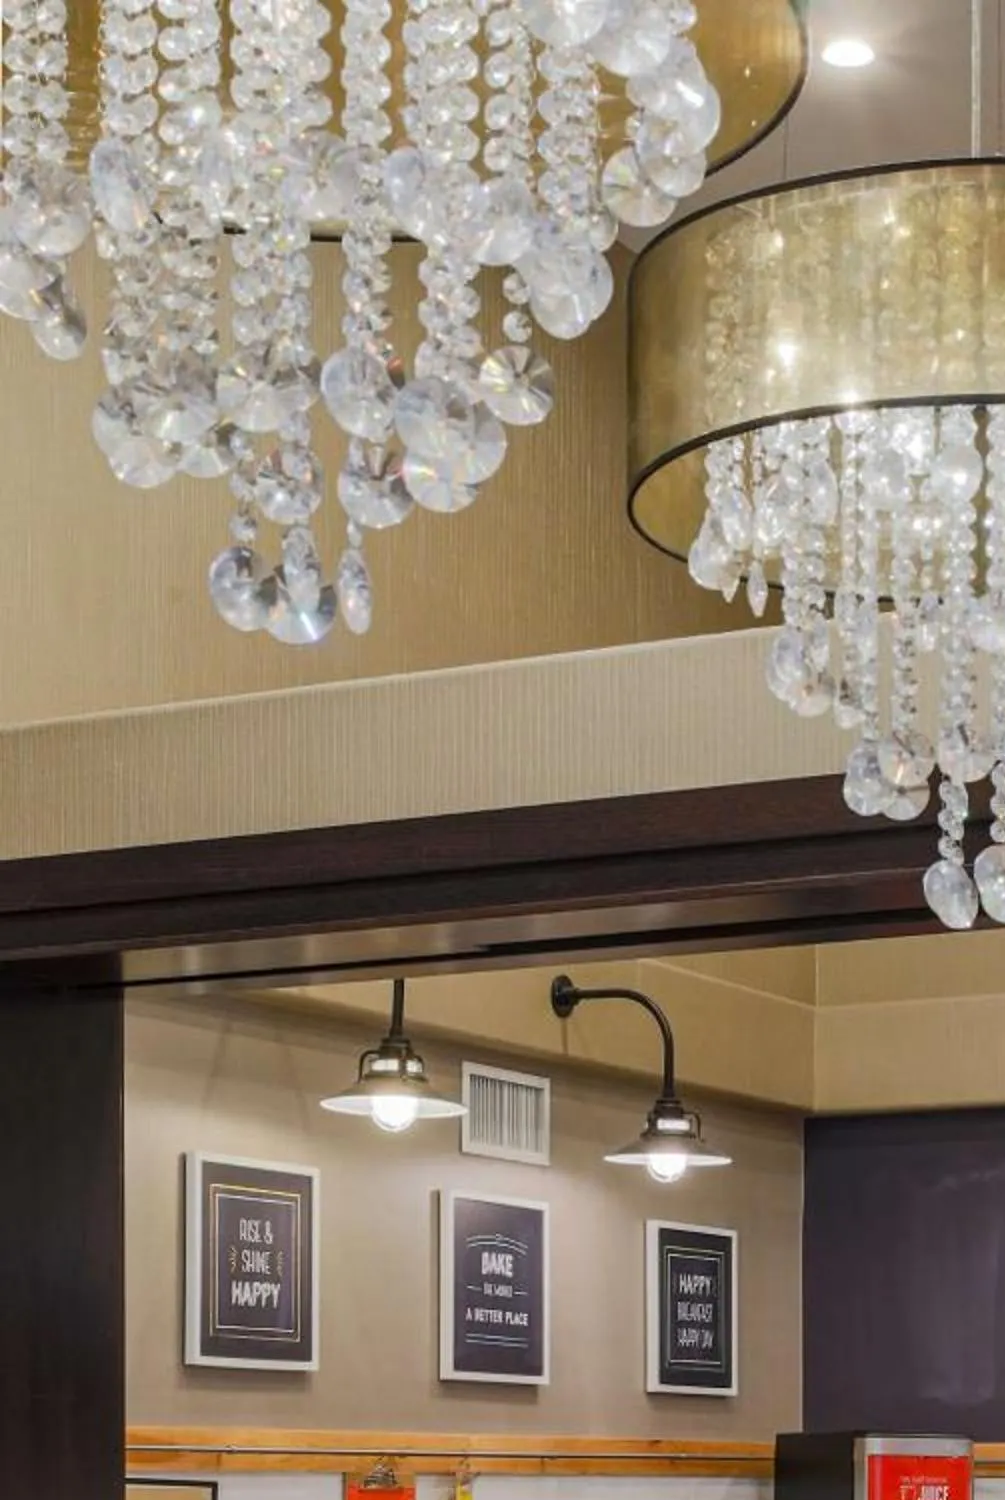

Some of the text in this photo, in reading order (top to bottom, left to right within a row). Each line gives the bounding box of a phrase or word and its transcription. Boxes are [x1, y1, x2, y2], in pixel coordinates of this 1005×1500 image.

[239, 1217, 273, 1245] RISE &
[241, 1249, 271, 1275] SHINE
[481, 1251, 513, 1278] BAKE
[231, 1280, 281, 1308] HAPPY
[678, 1273, 712, 1297] HAPPY
[465, 1307, 529, 1327] A BETTER PLACE
